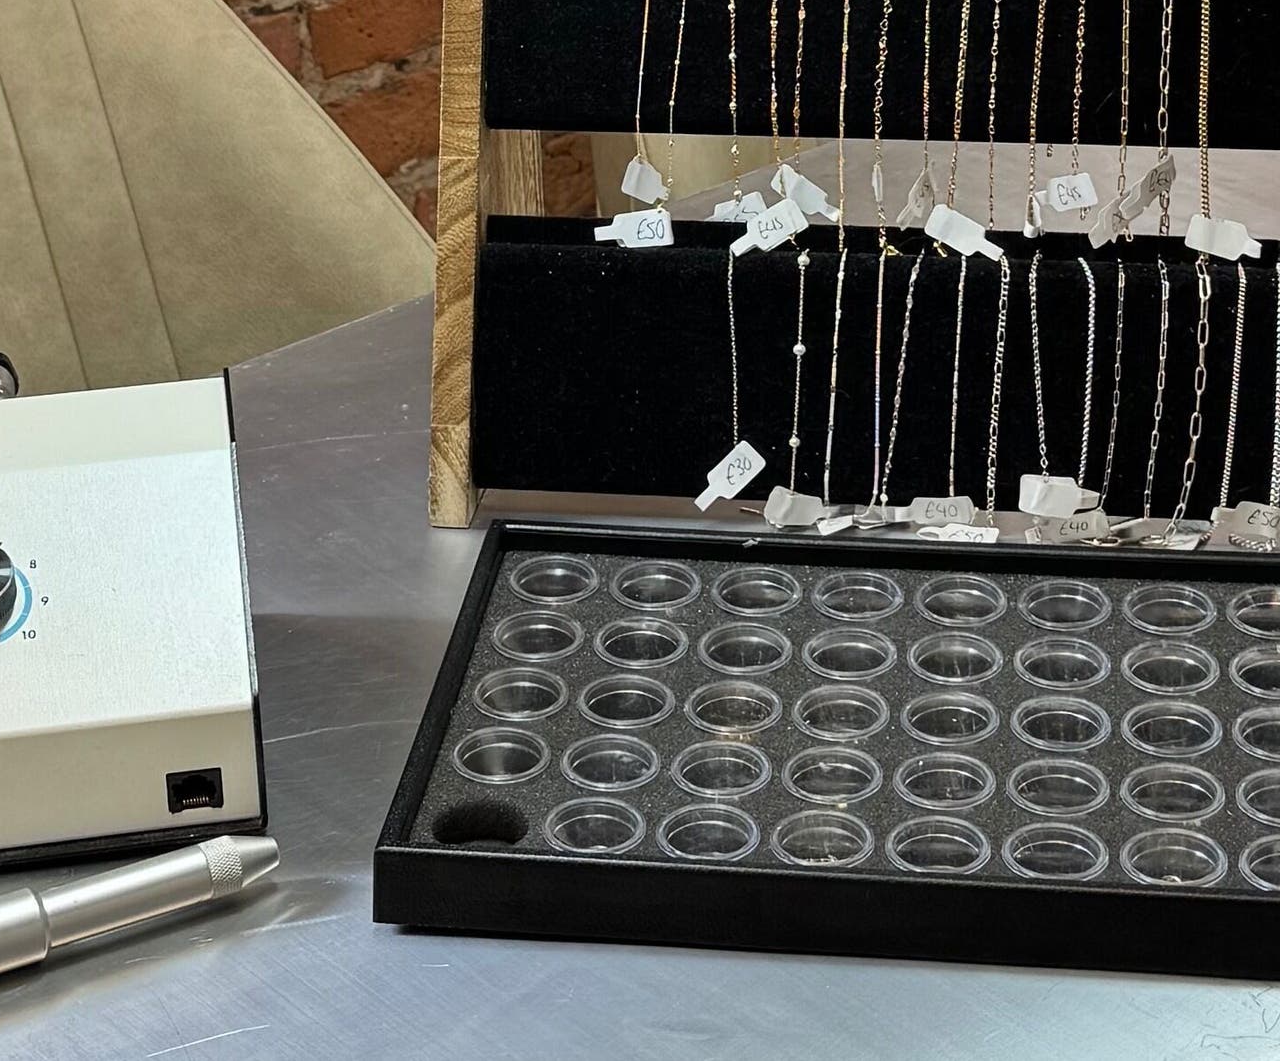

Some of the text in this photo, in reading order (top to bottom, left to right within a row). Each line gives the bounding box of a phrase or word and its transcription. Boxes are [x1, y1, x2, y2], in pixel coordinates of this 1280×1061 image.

[636, 217, 665, 241] £50
[725, 456, 753, 486] £30
[925, 500, 958, 519] £40
[1247, 509, 1280, 528] £50
[1060, 520, 1089, 536] £40
[29, 559, 38, 570] 8
[41, 596, 49, 607] 9
[22, 629, 37, 640] 10
